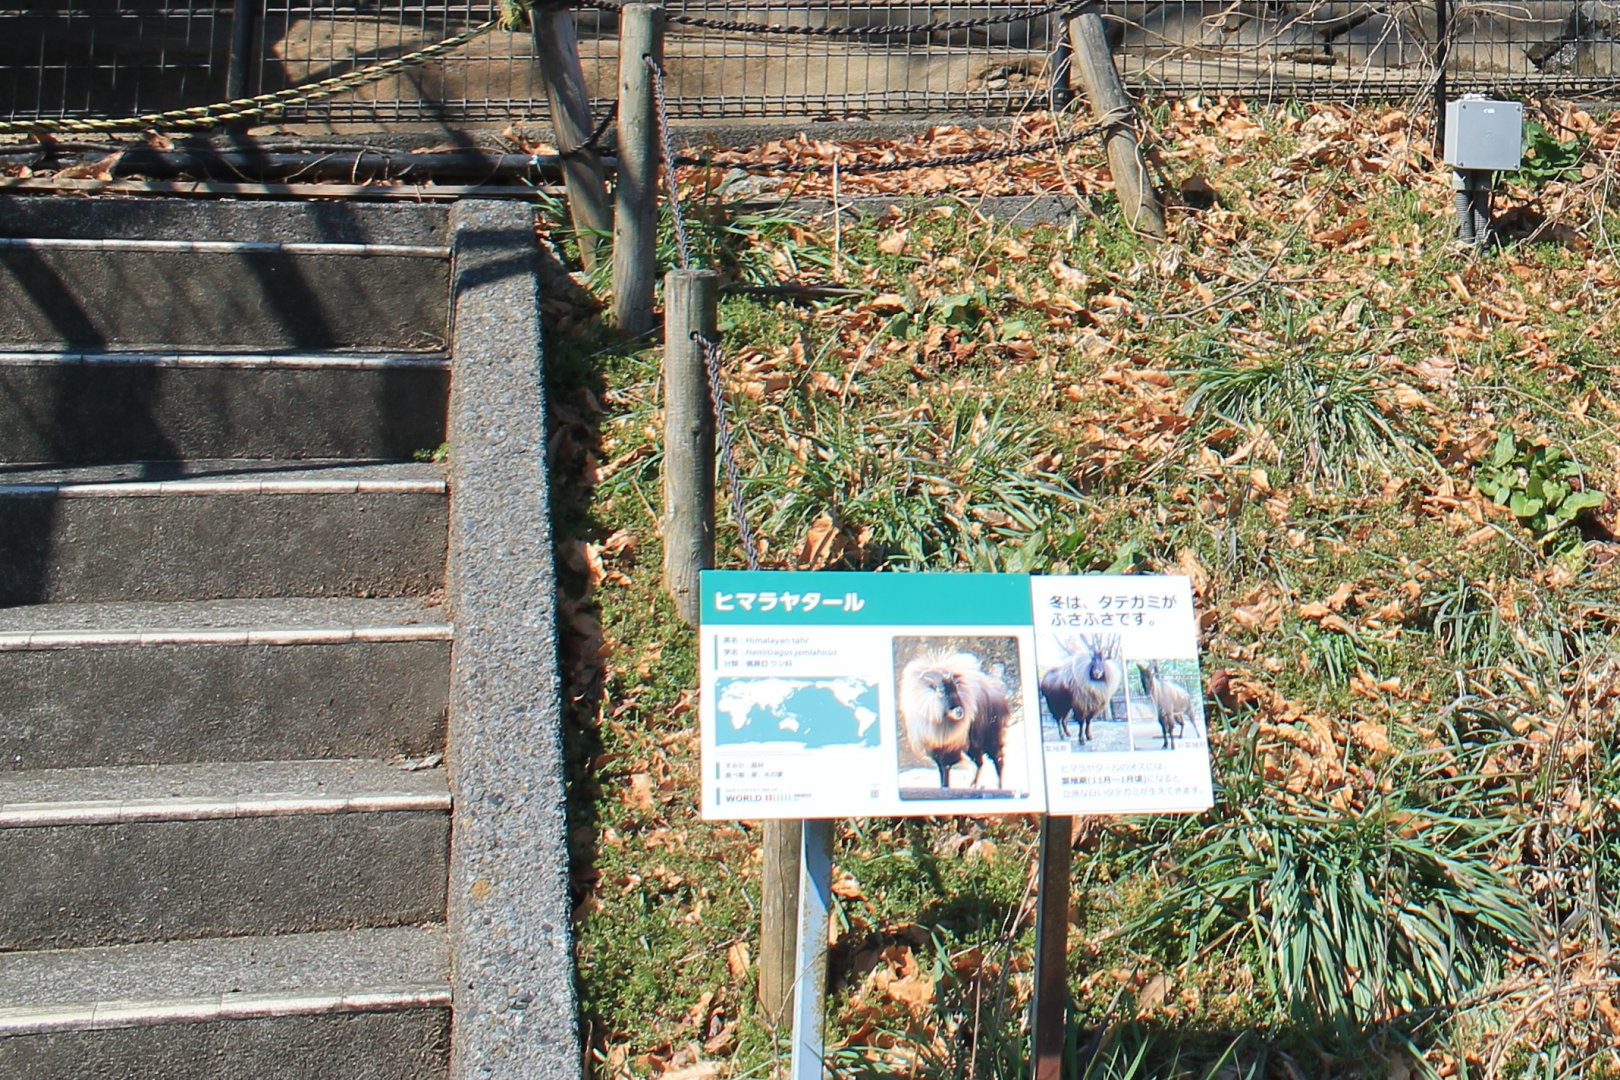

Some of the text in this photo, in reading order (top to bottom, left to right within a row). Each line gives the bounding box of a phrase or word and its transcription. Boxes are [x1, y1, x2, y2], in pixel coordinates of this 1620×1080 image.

[714, 591, 865, 612] ヒマラヤタール
[1050, 595, 1177, 609] 冬は、タテガミが
[1051, 612, 1155, 626] ふさふさです。
[726, 794, 762, 802] WORLD
